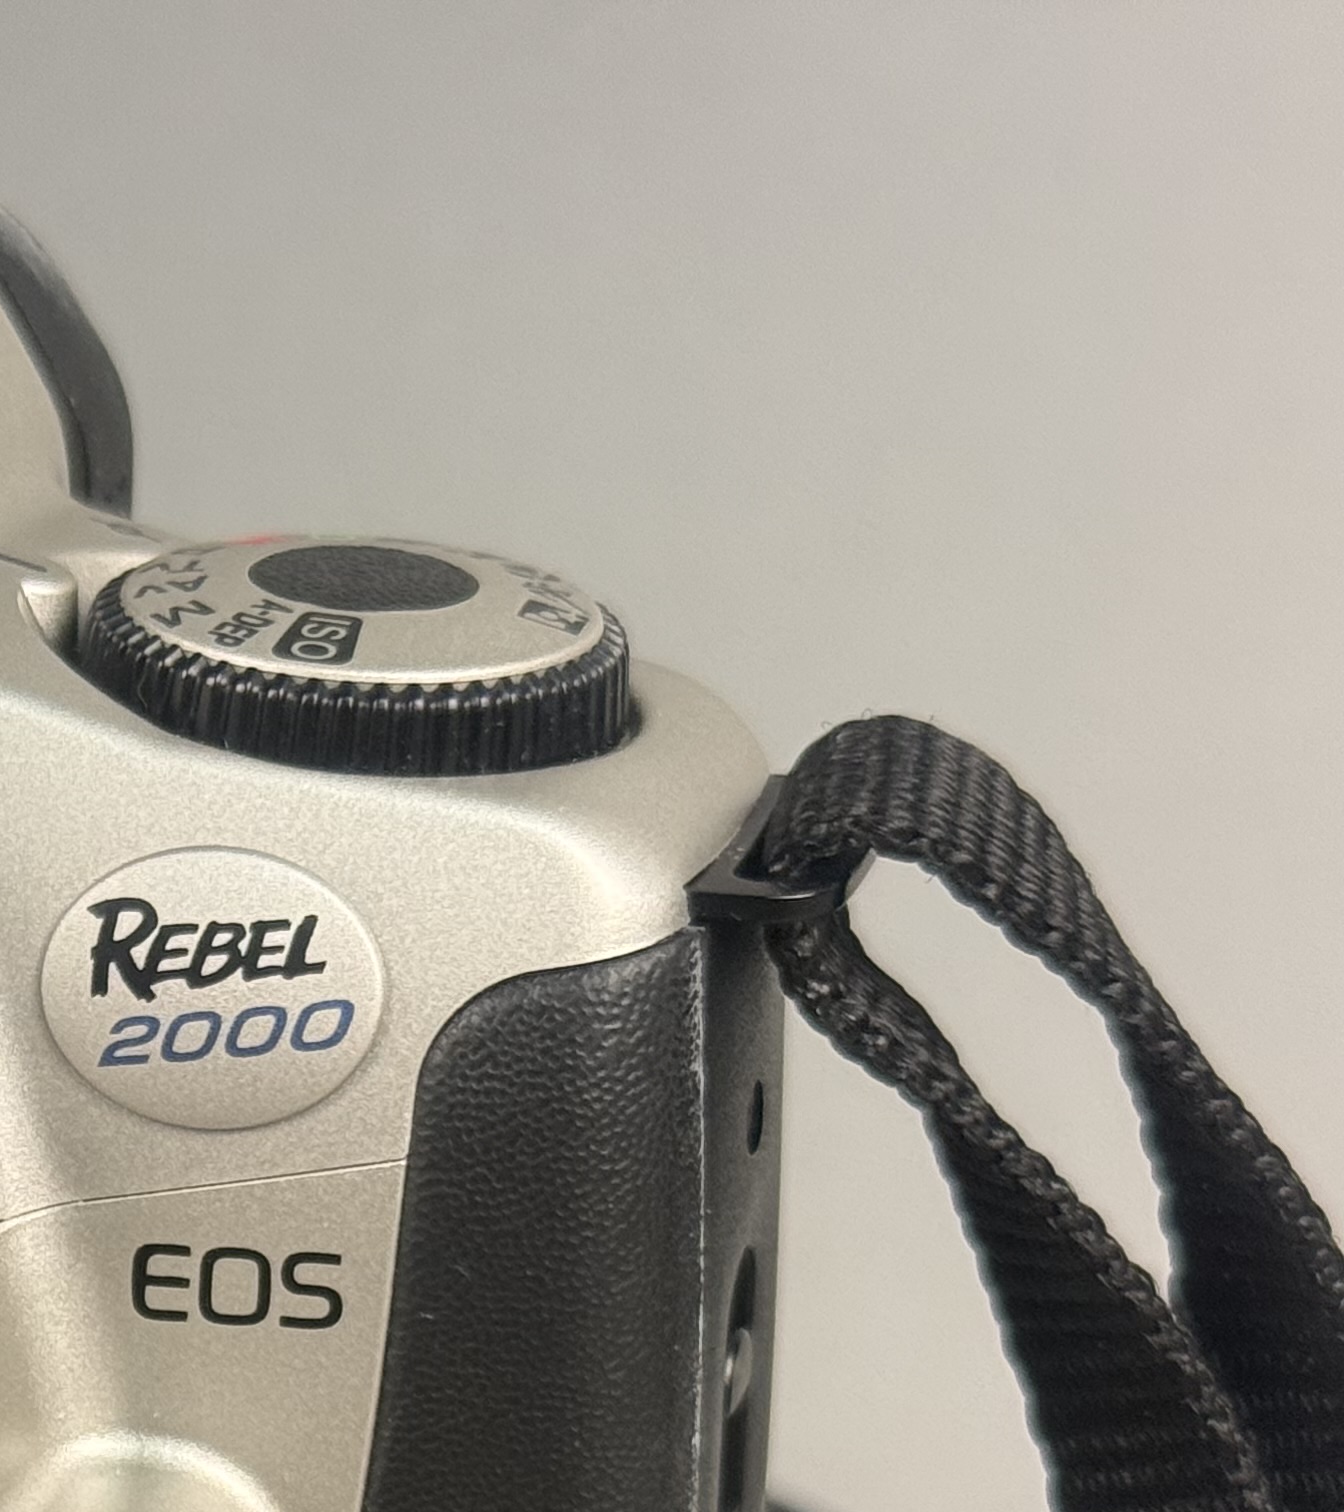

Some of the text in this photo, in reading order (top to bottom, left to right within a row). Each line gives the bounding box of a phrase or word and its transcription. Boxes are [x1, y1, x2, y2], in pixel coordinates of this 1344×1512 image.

[149, 599, 217, 630] M
[207, 598, 295, 648] A-DEP
[289, 616, 354, 661] ISO
[87, 897, 328, 1003] REBEL
[97, 999, 356, 1068] 2000
[131, 1242, 344, 1330] EOS
